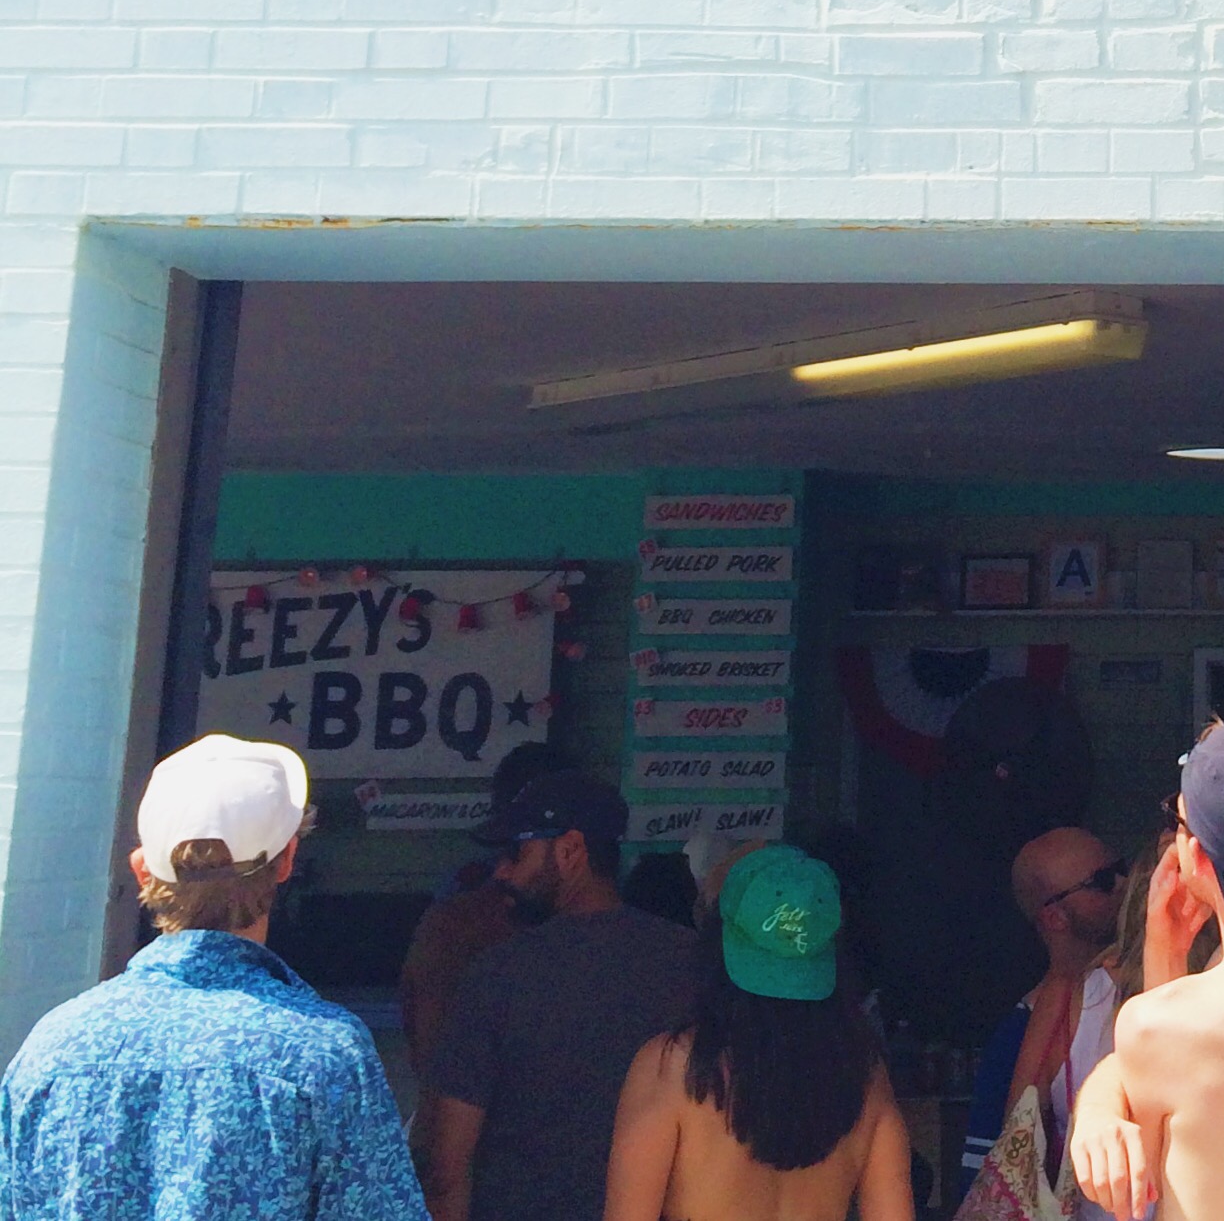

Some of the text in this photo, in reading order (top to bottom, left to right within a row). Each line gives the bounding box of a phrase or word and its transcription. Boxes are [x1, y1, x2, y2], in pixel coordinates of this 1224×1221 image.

[655, 502, 788, 522] SANDWICHES
[650, 554, 783, 573] PULLED PORK
[1056, 549, 1091, 587] A
[658, 608, 779, 625] BBQ CHICKEN
[649, 661, 785, 677] SMOKED BRISKET
[308, 671, 493, 762] BBQ
[683, 707, 749, 729] SIDES
[644, 760, 775, 777] POTATO SALAD
[646, 806, 775, 837] SLAW! SLAW!
